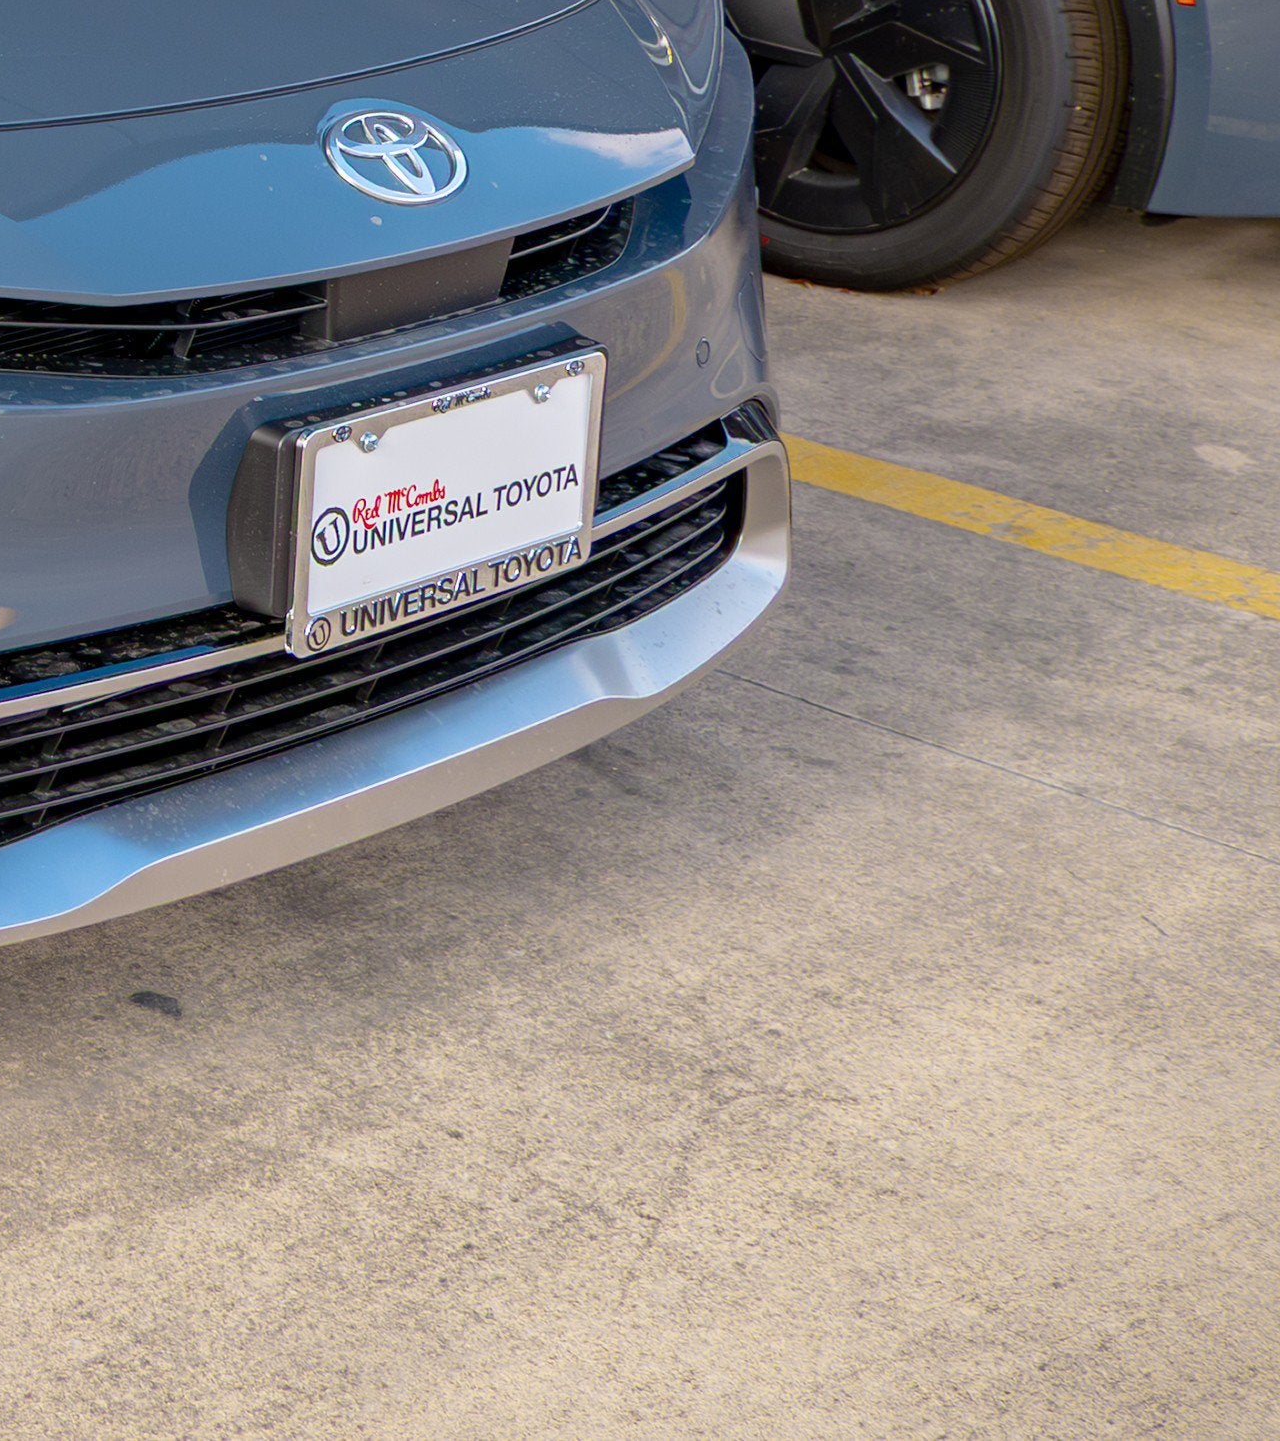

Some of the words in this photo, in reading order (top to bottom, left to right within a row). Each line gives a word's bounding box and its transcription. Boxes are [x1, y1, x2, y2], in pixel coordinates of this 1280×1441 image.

[352, 494, 382, 530] Red
[384, 478, 446, 515] McCombs
[353, 491, 488, 554] UNIVERSAL
[493, 463, 579, 511] TOYOTA
[340, 567, 486, 636] UNIVERSAL
[487, 535, 582, 587] TOYOTA
